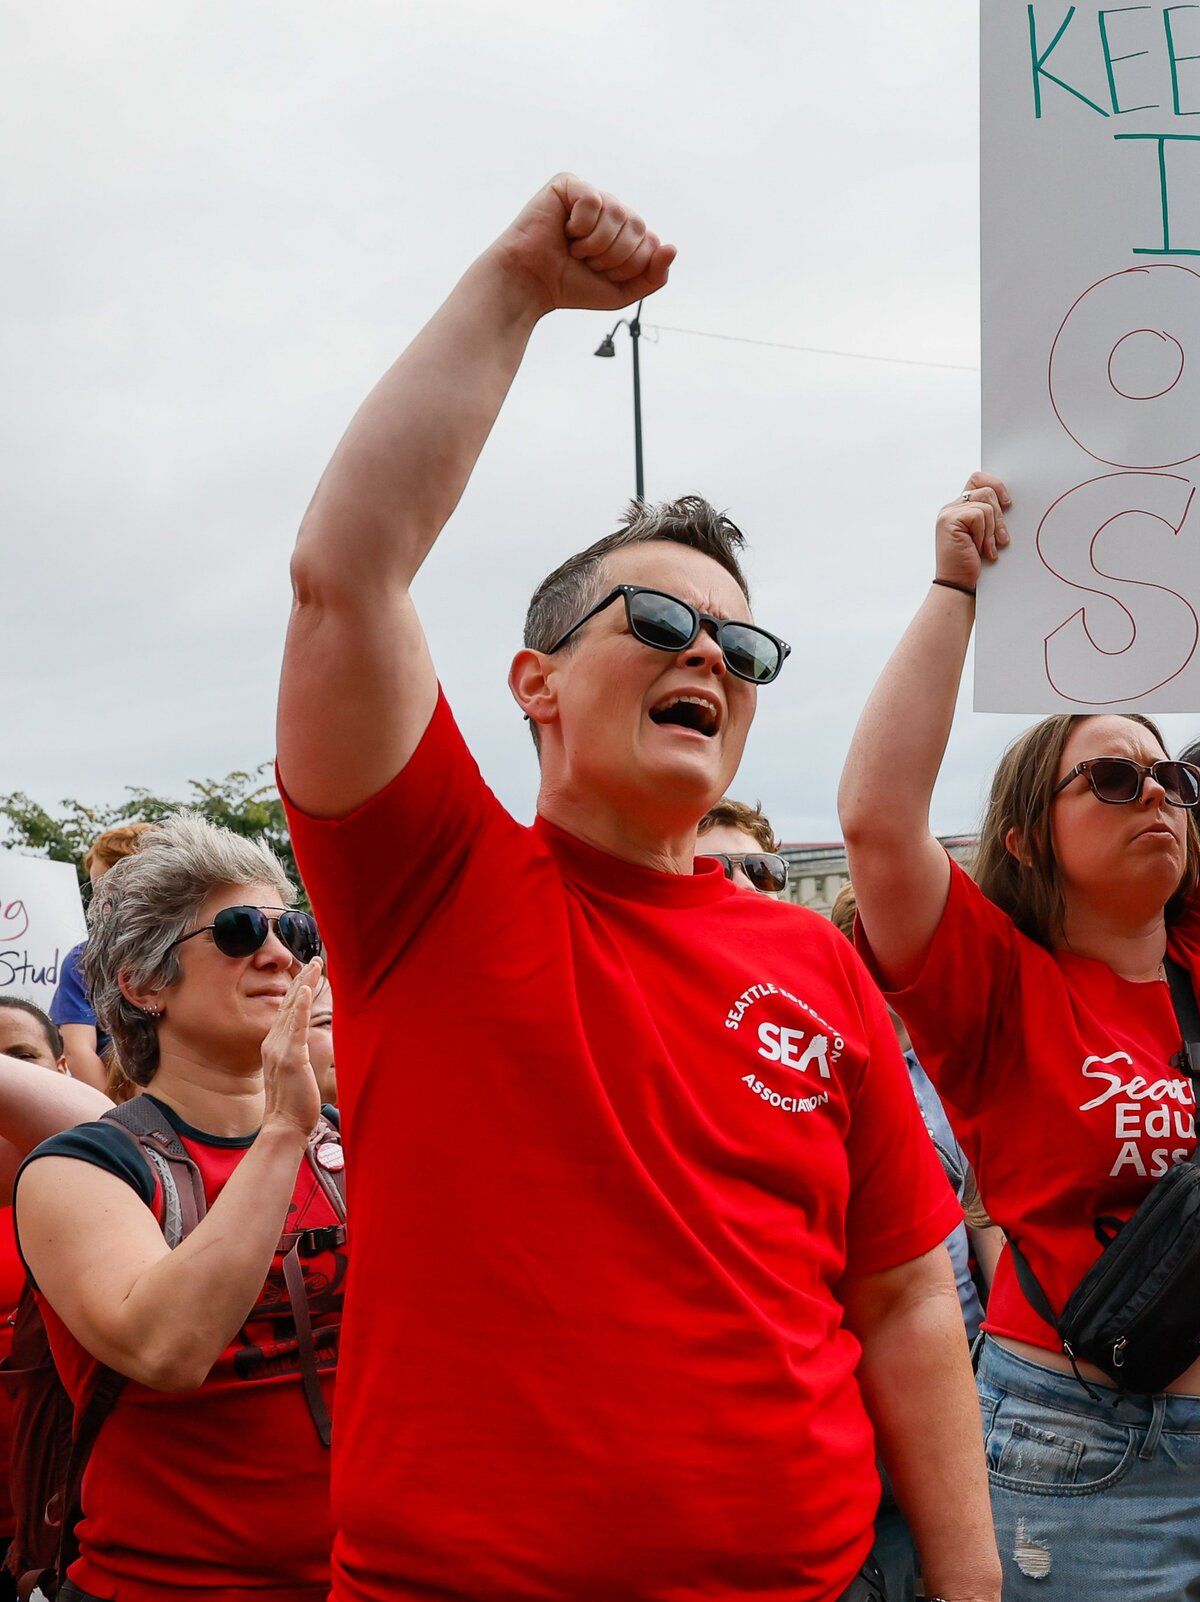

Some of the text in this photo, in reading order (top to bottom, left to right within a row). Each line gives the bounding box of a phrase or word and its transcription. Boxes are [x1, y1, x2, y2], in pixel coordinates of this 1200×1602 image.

[725, 982, 779, 1031] SEATTLE
[757, 1022, 831, 1079] SEA
[741, 1073, 829, 1113] ASSOCIATION
